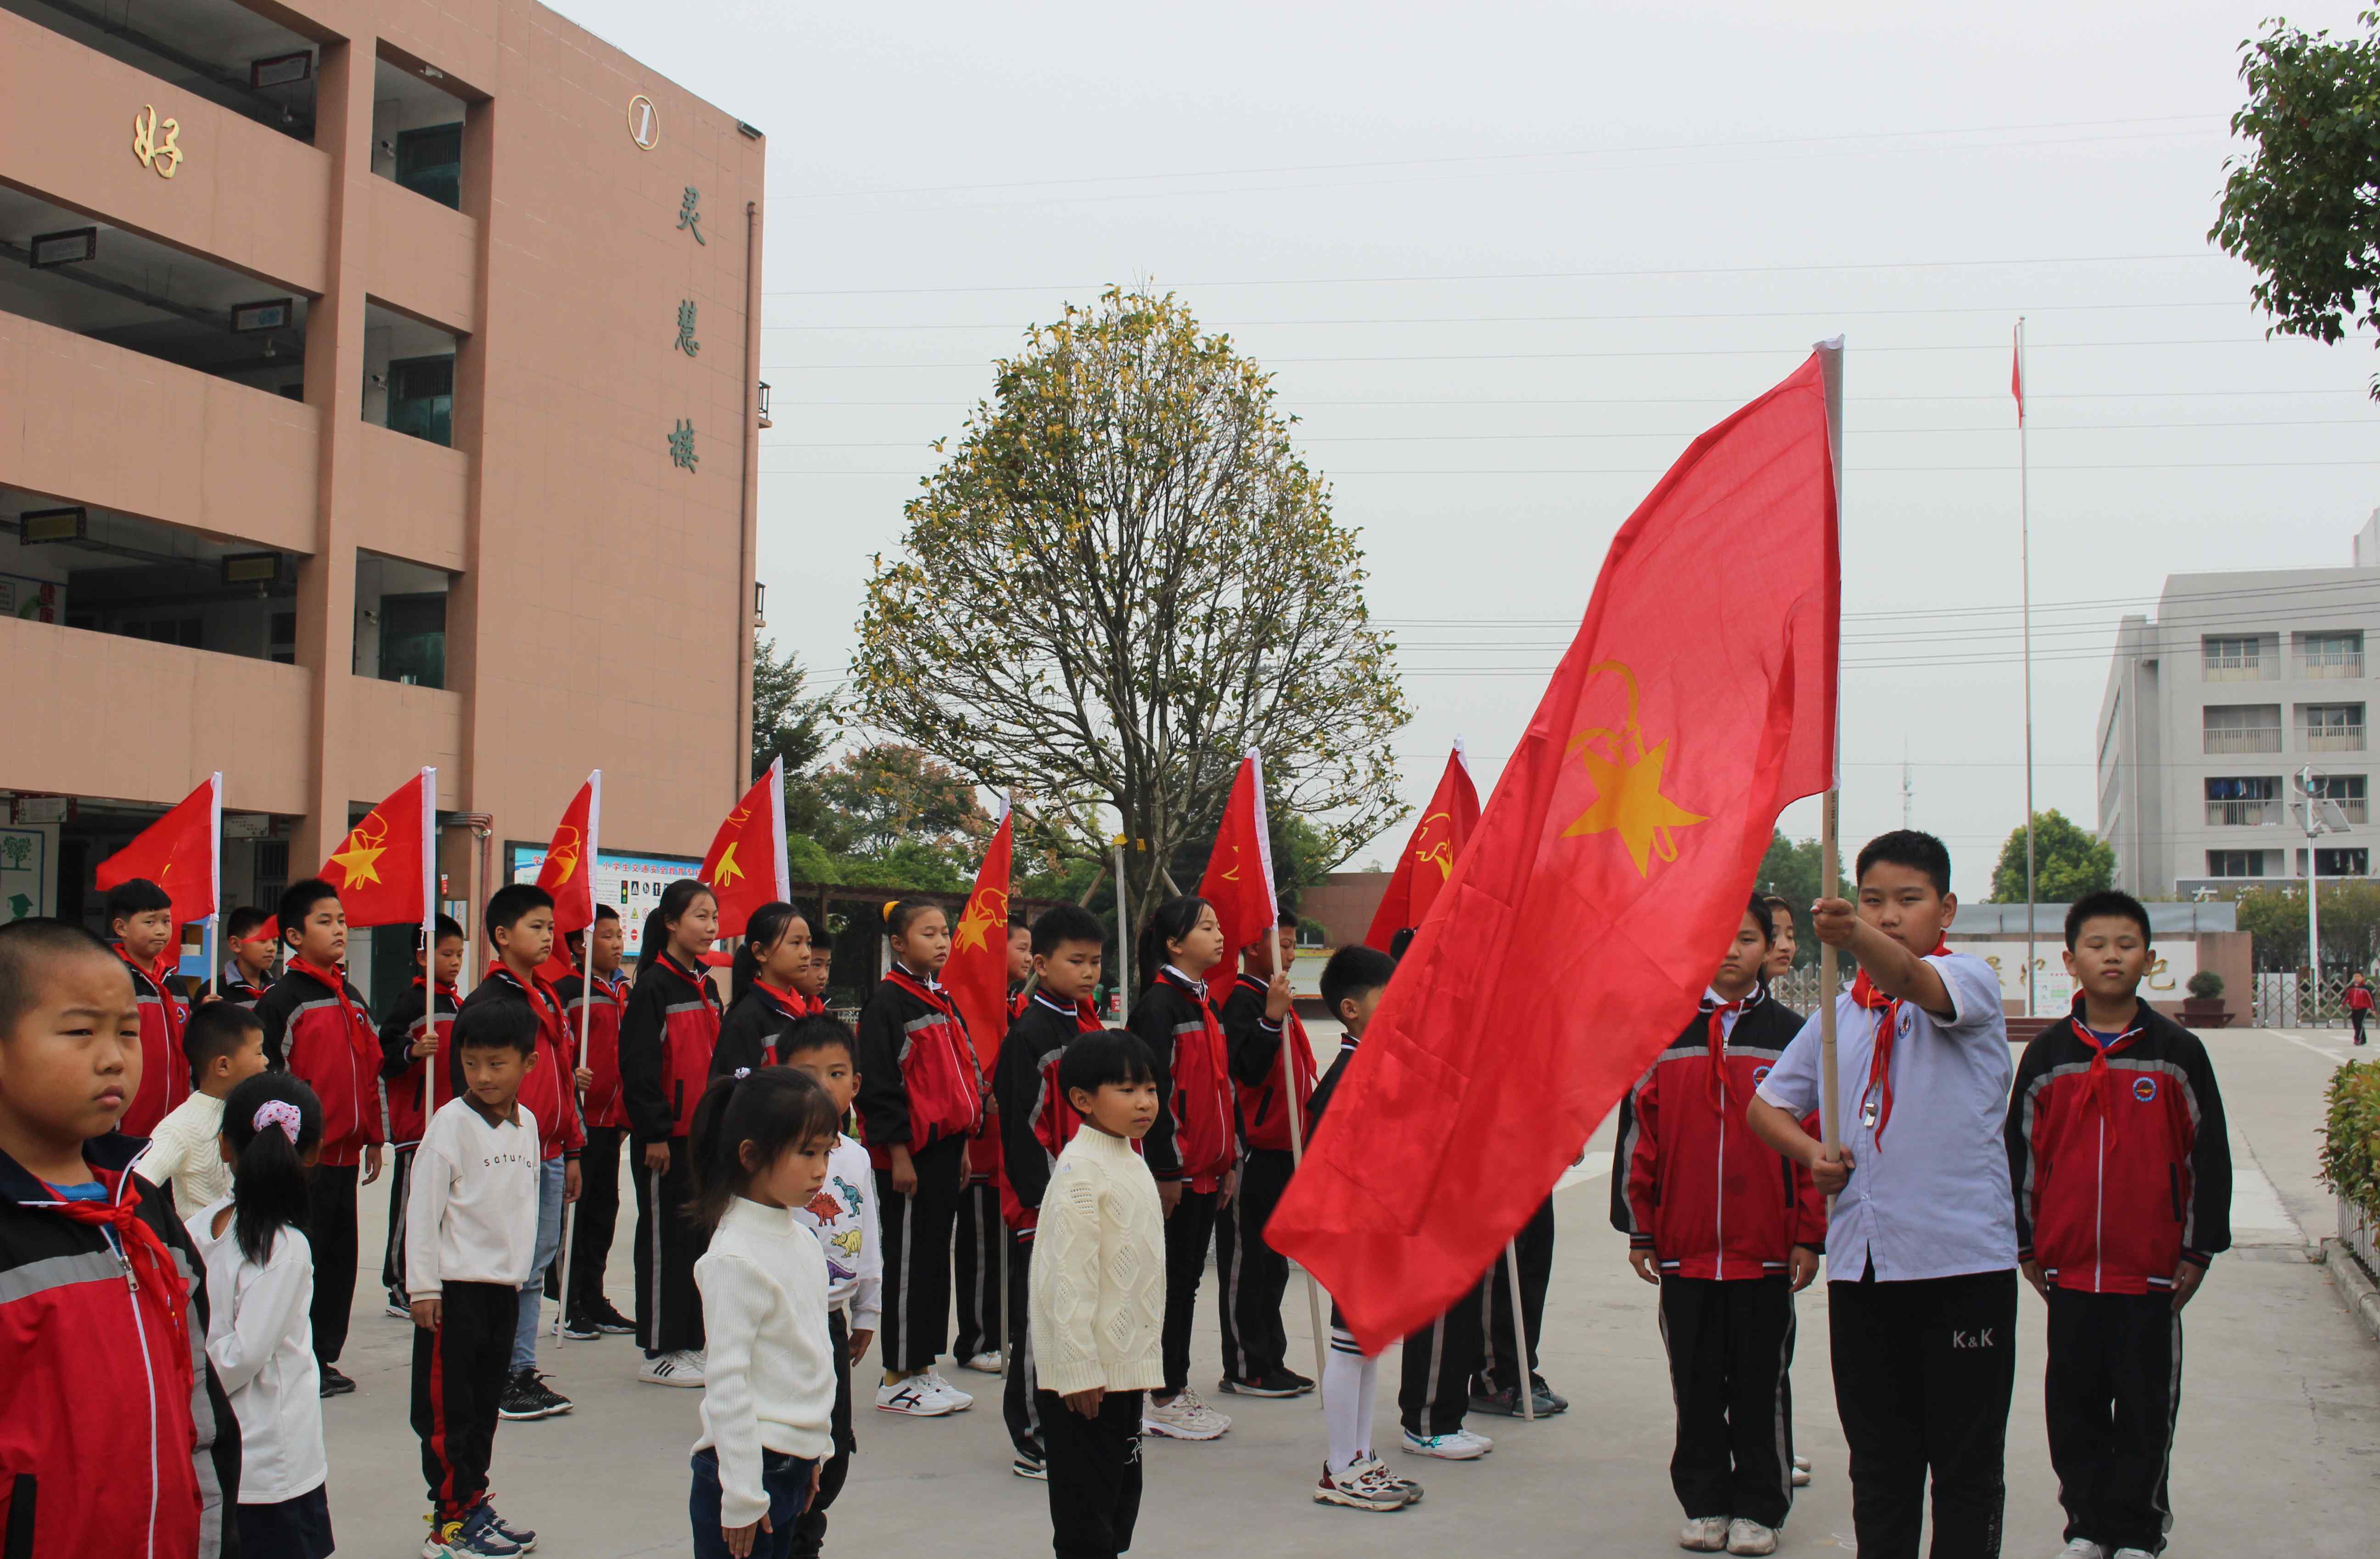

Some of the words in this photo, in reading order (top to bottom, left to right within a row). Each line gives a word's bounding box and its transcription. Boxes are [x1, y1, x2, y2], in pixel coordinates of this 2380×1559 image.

[134, 104, 183, 178] 好
[635, 104, 651, 146] 1
[668, 186, 706, 474] 灵慧楼
[1953, 1327, 1994, 1348] K&K
